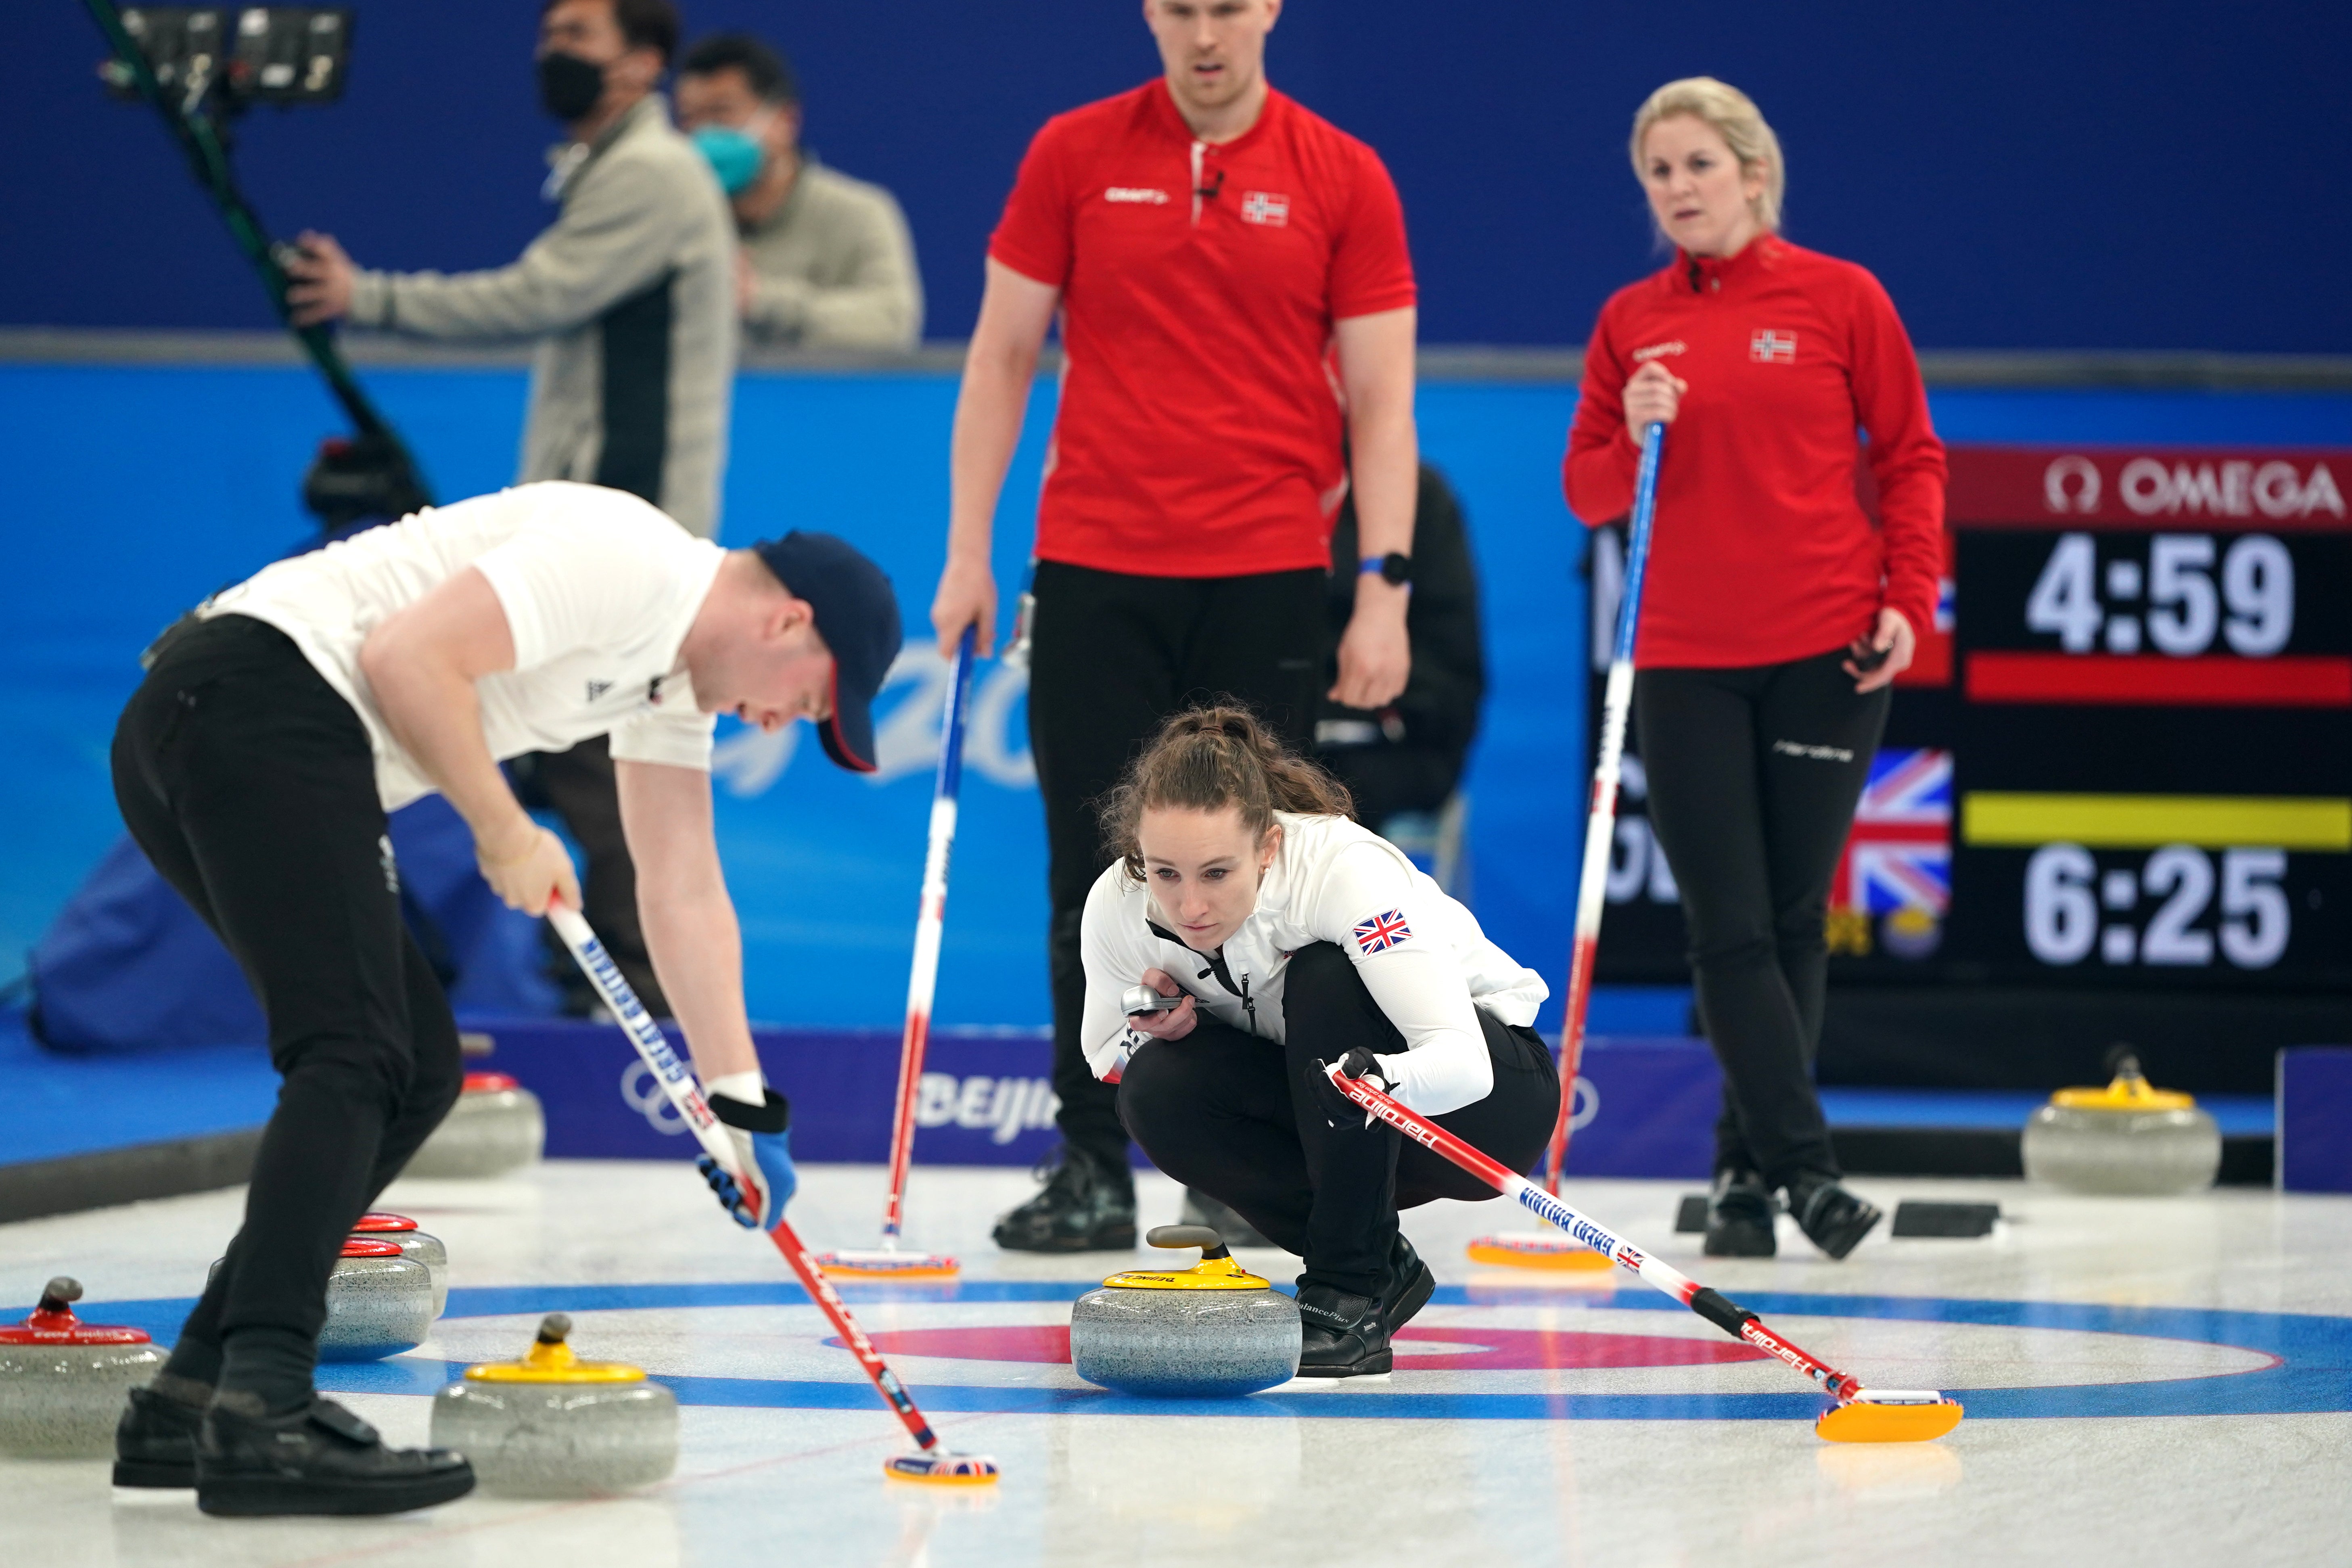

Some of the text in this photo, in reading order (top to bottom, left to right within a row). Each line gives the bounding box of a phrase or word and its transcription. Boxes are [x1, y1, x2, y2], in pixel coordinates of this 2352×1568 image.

[2118, 458, 2346, 519] OMEGA
[2026, 532, 2295, 659] 4:59
[2023, 843, 2291, 969] 6:25
[917, 1071, 1063, 1145] BEIJI
[1349, 1087, 1439, 1149] Hardline
[1365, 1086, 1379, 1096] carbon
[1520, 1187, 1616, 1257] GREAT BRITAIN
[1297, 1302, 1350, 1323] alancePlus
